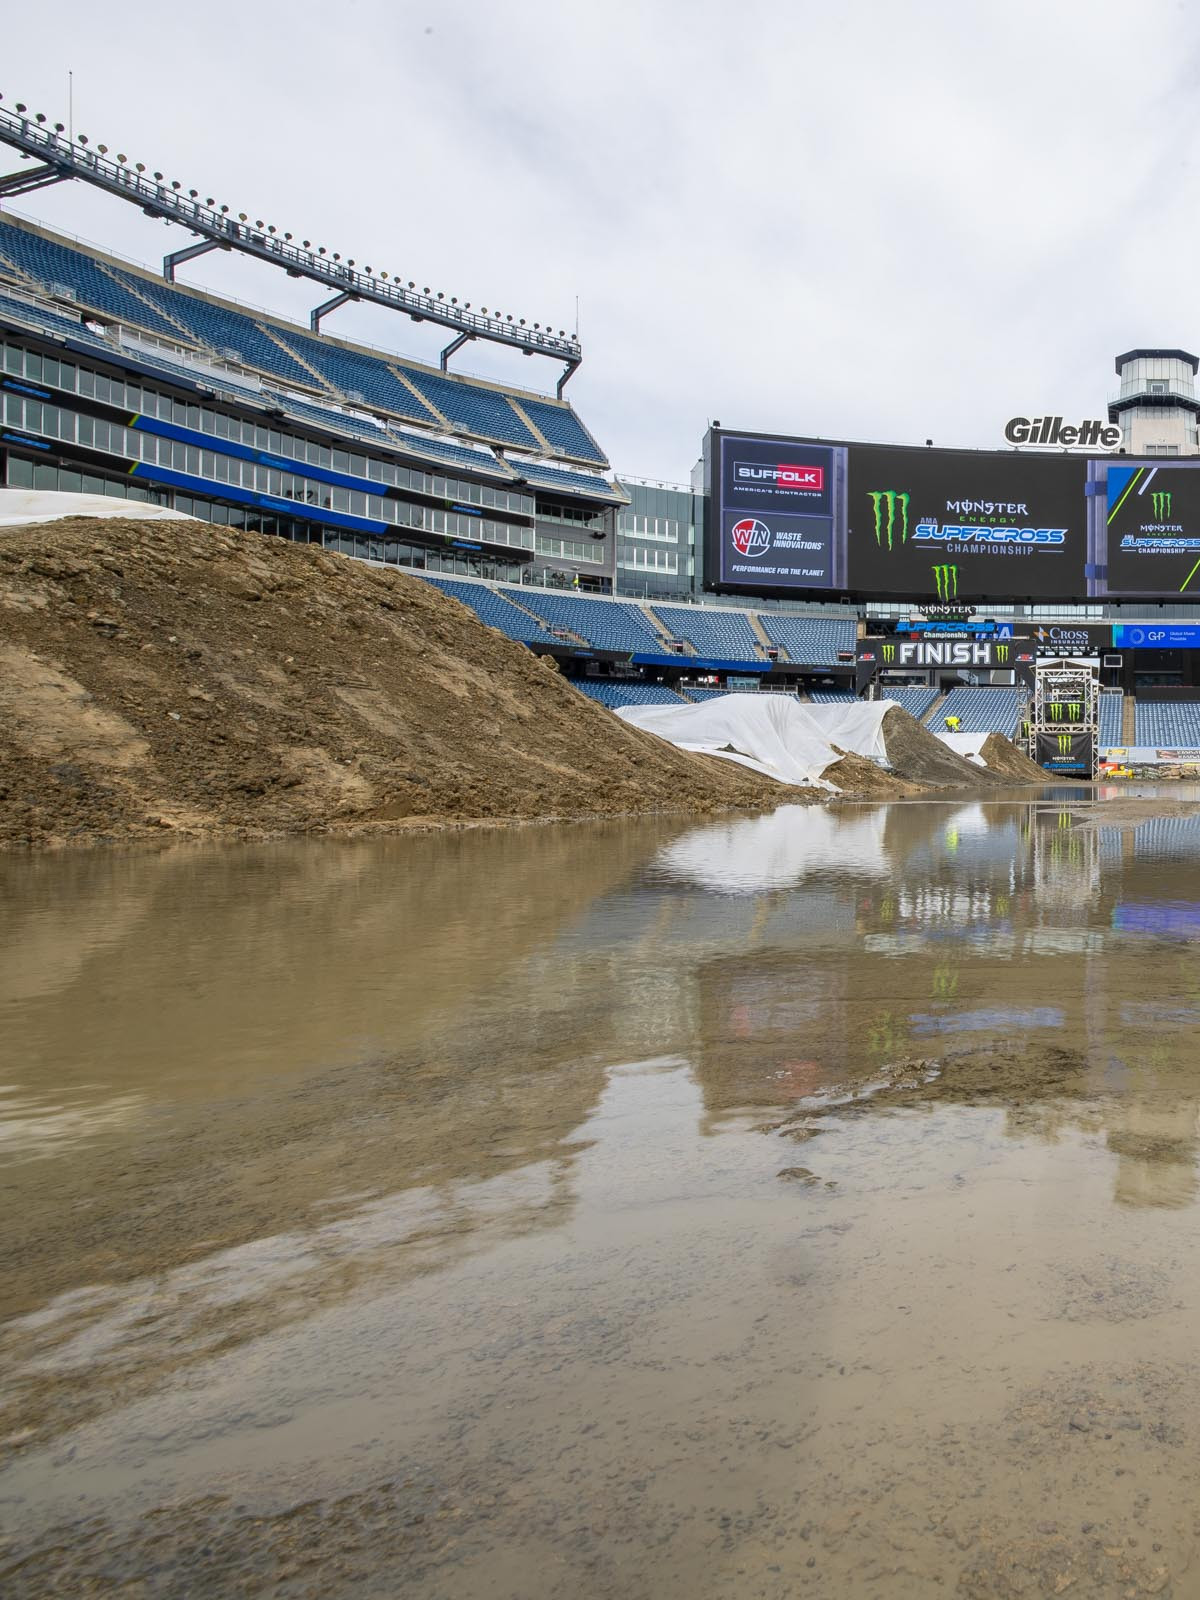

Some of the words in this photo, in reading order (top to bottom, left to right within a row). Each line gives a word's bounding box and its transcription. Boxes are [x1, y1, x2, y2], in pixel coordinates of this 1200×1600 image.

[1004, 416, 1120, 447] Gillette
[738, 468, 816, 483] SUFFOLK
[733, 486, 773, 494] AMERICA'S
[774, 489, 822, 497] CONTRACTOR
[946, 499, 1029, 516] MONSTER
[920, 517, 938, 525] AMA
[959, 516, 1017, 524] ENERGY
[911, 523, 1069, 544] SUPERCROSS
[1140, 524, 1183, 532] MONSTER
[732, 529, 771, 547] WIN
[776, 532, 802, 540] WASTE
[946, 543, 1034, 555] CHAMPIONSHIP
[732, 565, 776, 574] PERFORMANCE
[919, 605, 973, 614] MONSTER
[896, 622, 995, 632] SUPERCROSS
[900, 642, 991, 664] FINISH
